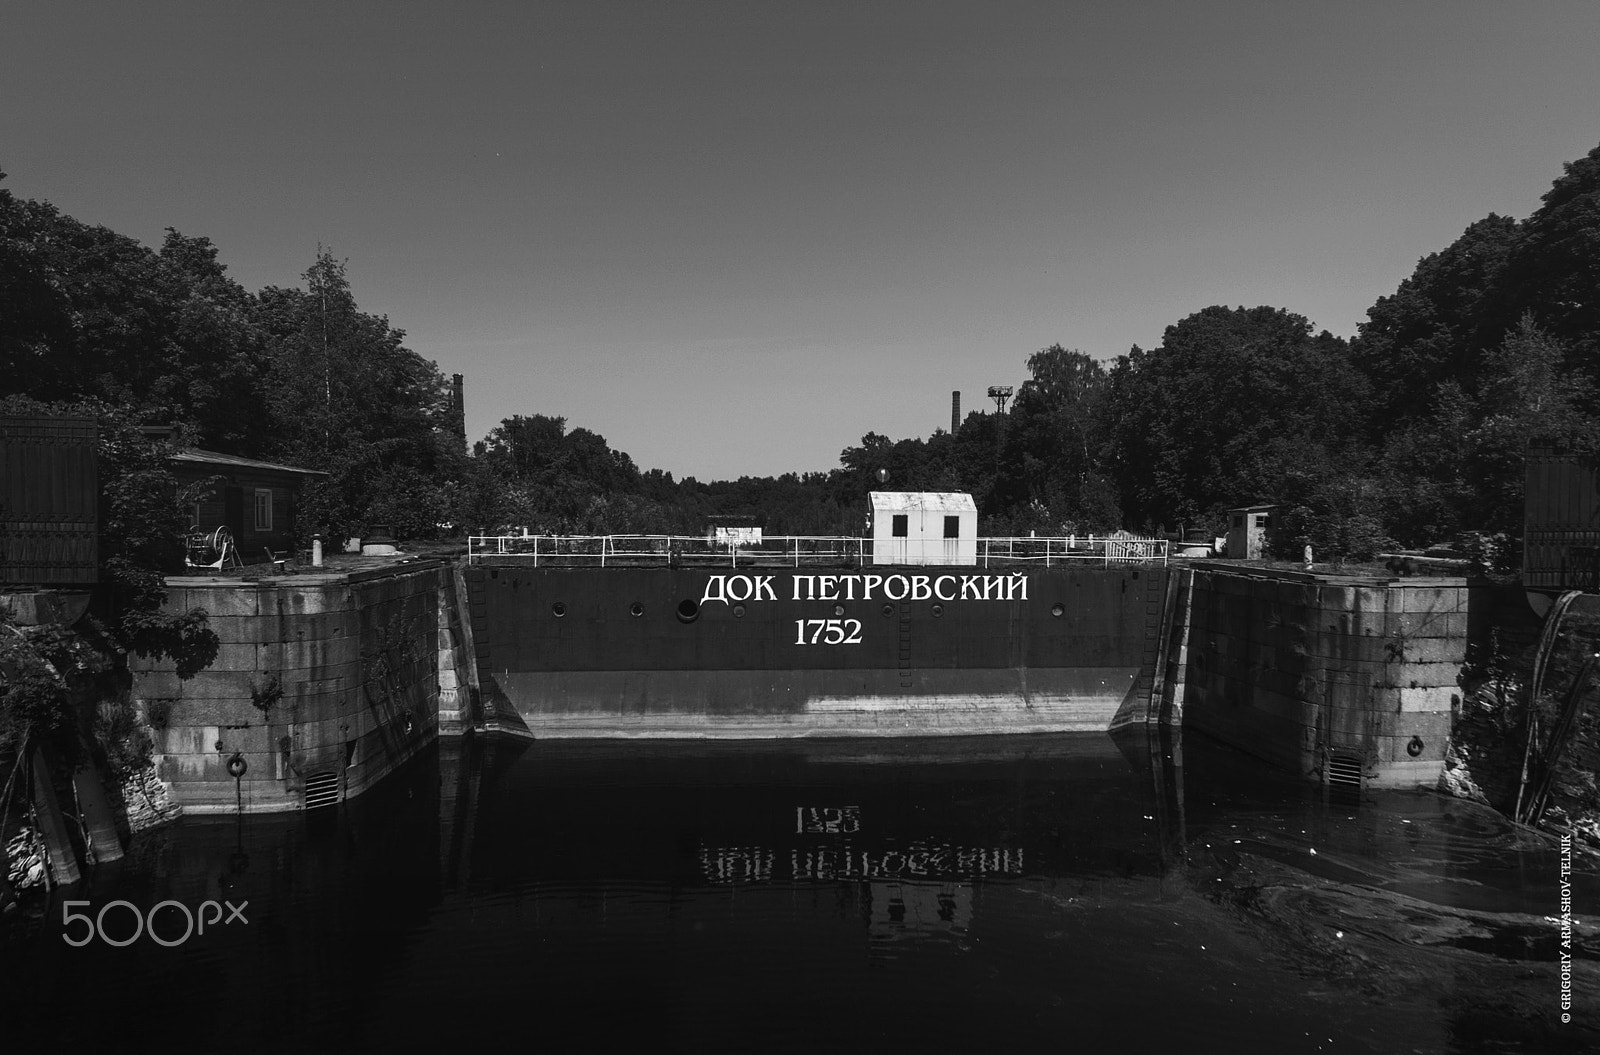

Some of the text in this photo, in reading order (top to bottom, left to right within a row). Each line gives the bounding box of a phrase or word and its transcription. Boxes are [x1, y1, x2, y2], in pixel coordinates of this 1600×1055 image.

[700, 572, 1029, 606] ДОК ПЕТРОВСКИЙ
[794, 619, 863, 645] 1752
